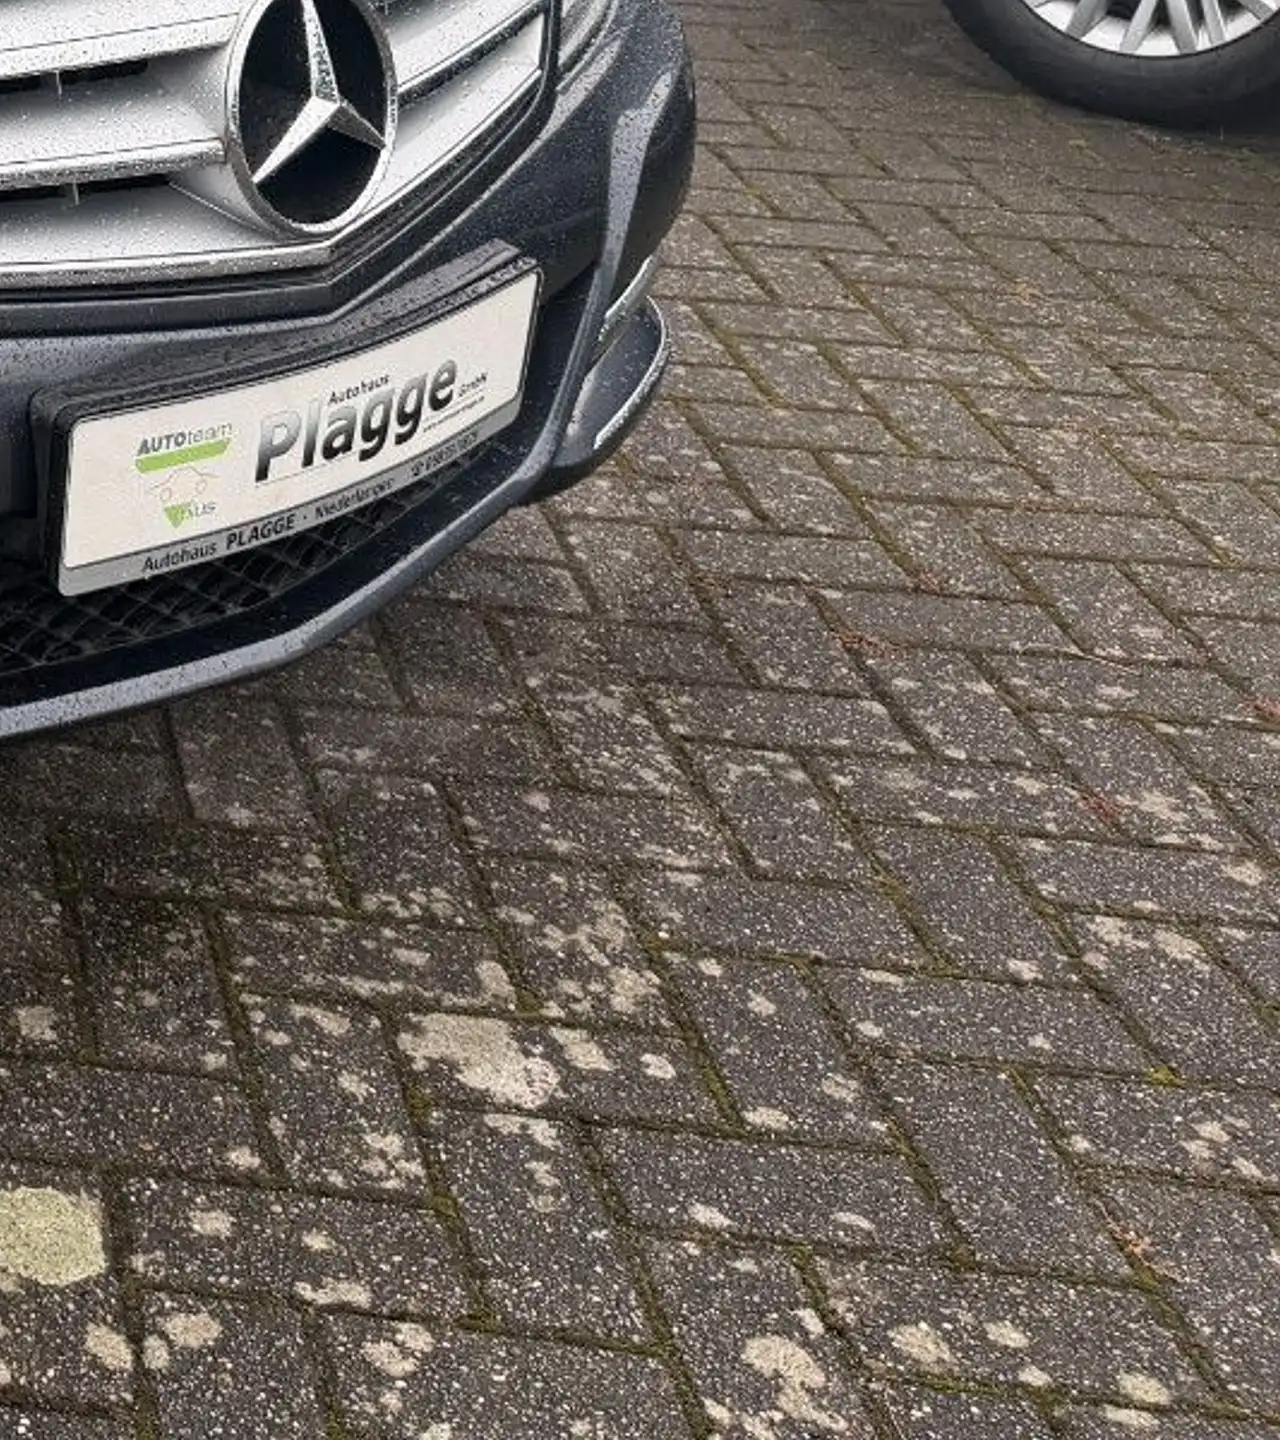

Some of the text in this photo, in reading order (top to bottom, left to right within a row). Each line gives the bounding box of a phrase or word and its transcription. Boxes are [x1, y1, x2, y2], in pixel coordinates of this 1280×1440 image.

[328, 374, 391, 406] Autohaus
[138, 422, 233, 455] AUTOteam
[254, 359, 458, 483] Plagge
[141, 541, 218, 573] Autohaus
[224, 514, 297, 551] PLAGGE
